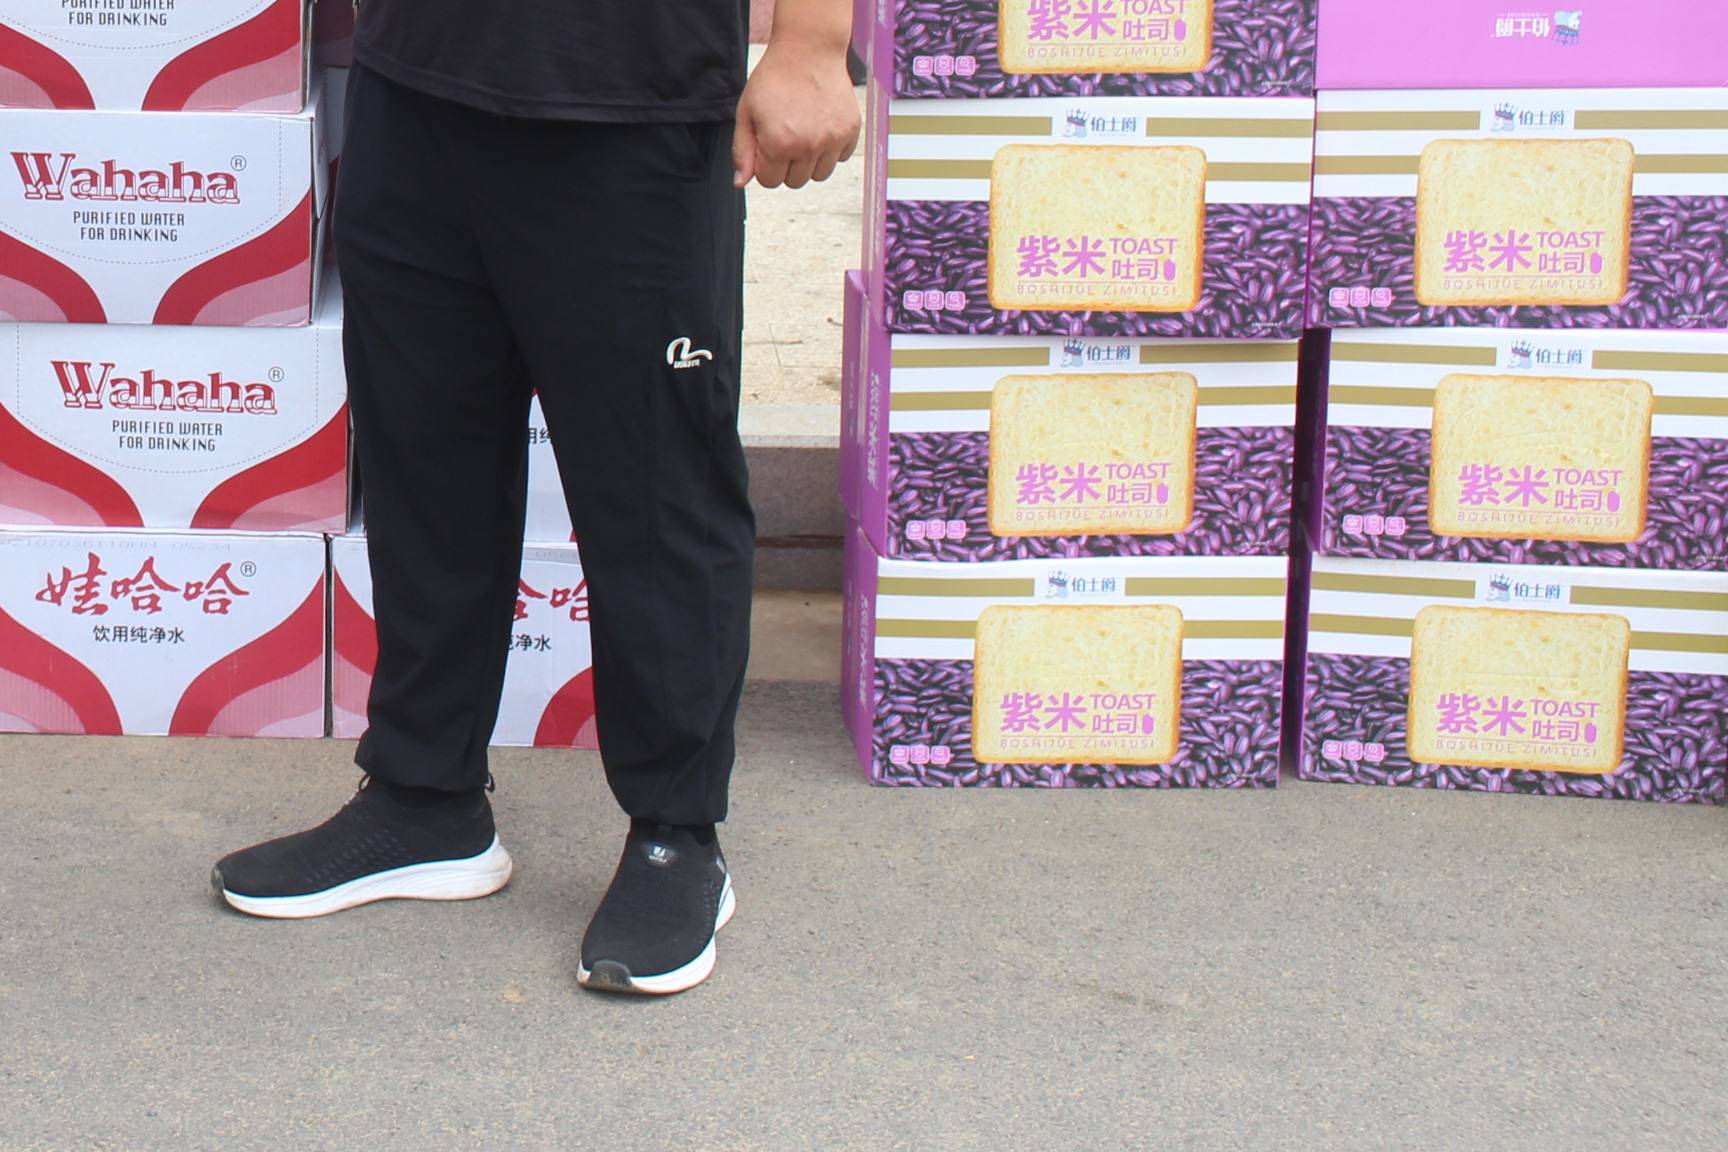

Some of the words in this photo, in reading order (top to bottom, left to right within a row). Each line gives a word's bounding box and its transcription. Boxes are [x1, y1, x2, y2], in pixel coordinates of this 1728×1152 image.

[69, 12, 92, 25] FOR
[98, 12, 167, 26] DRINKING
[1123, 20, 1170, 40] 吐司
[1091, 117, 1137, 133] 伯士爵
[1519, 110, 1565, 126] 伯士爵
[10, 152, 240, 204] Wahaha
[73, 211, 135, 226] PURIFIED
[140, 212, 184, 226] WATER
[81, 226, 104, 241] FOR
[109, 228, 178, 242] DRINKING
[1537, 231, 1603, 248] TOAST
[1111, 238, 1177, 255] TOAST
[1444, 230, 1533, 273] 紫米
[1017, 235, 1106, 279] 紫米
[1539, 253, 1586, 274] 吐司
[1113, 260, 1160, 280] 吐司
[1086, 345, 1131, 361] 伯士爵
[1536, 349, 1582, 365] 伯士爵
[51, 361, 278, 415] Wahaha
[112, 420, 174, 435] PURIFIED
[180, 421, 222, 436] WATER
[119, 436, 143, 450] FOR
[147, 437, 215, 451] DRINKING
[1105, 464, 1170, 479] TOAST
[1553, 468, 1622, 487] TOAST
[1016, 463, 1102, 504] 紫米
[1459, 465, 1550, 507] 紫米
[1108, 484, 1153, 504] 吐司
[1555, 491, 1603, 512] 吐司
[35, 553, 251, 615] 娃哈哈
[1072, 577, 1116, 593] 伯士爵
[1514, 583, 1561, 600] 伯士爵
[93, 625, 185, 644] 饮用纯净水
[1091, 694, 1156, 709] TOAST
[1531, 699, 1599, 717] TOAST
[1001, 693, 1087, 733] 紫米
[1437, 695, 1527, 737] 紫米
[1093, 715, 1138, 734] 吐司
[1532, 721, 1580, 743] 吐司
